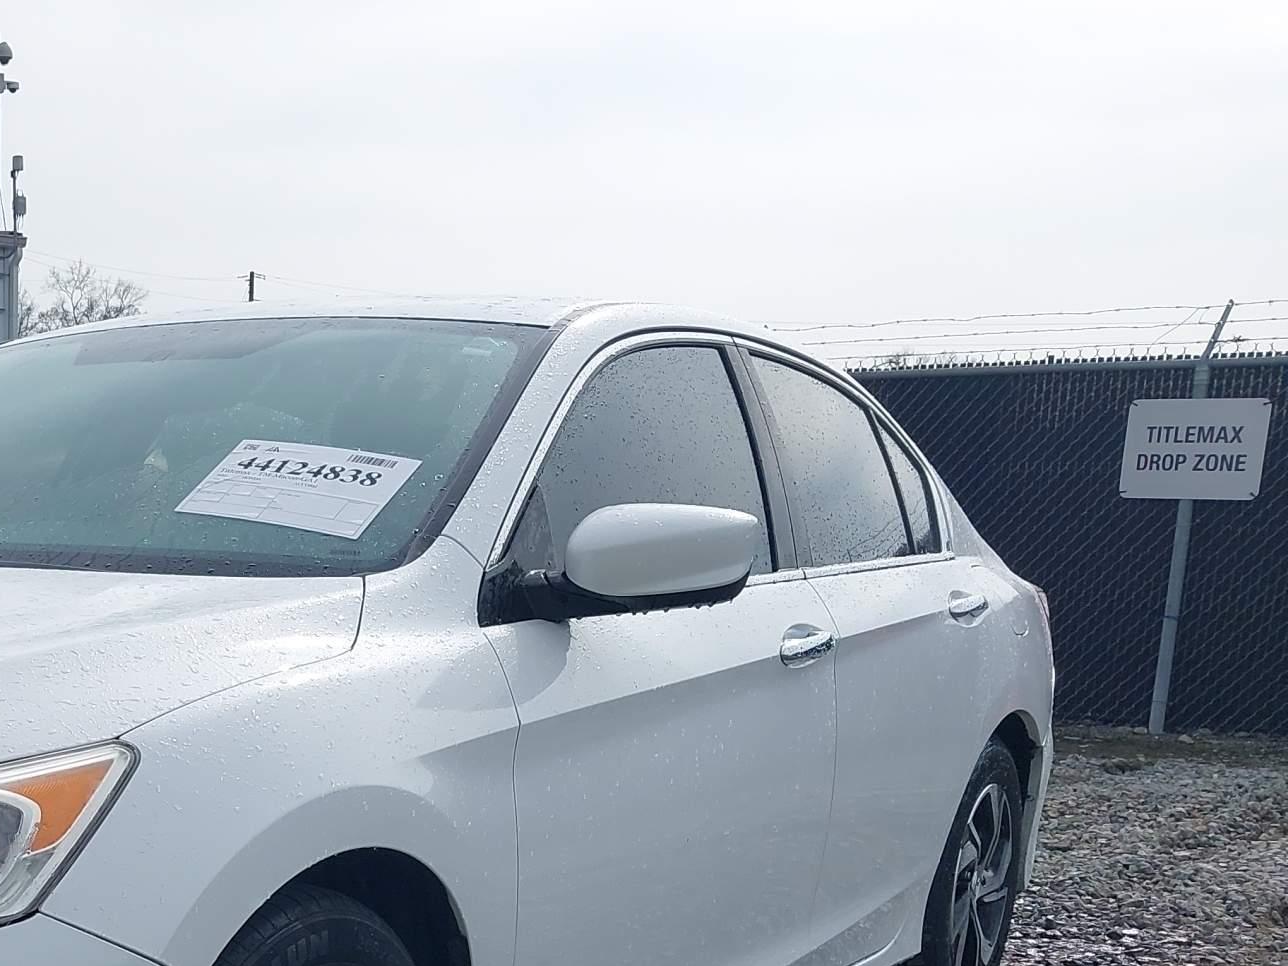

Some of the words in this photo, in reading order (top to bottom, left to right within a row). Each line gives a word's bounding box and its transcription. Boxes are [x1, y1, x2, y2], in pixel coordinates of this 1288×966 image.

[1146, 425, 1245, 444] TITLEMAX
[237, 456, 383, 487] 44124838
[1135, 453, 1188, 472] DROP
[1191, 453, 1249, 472] ZONE
